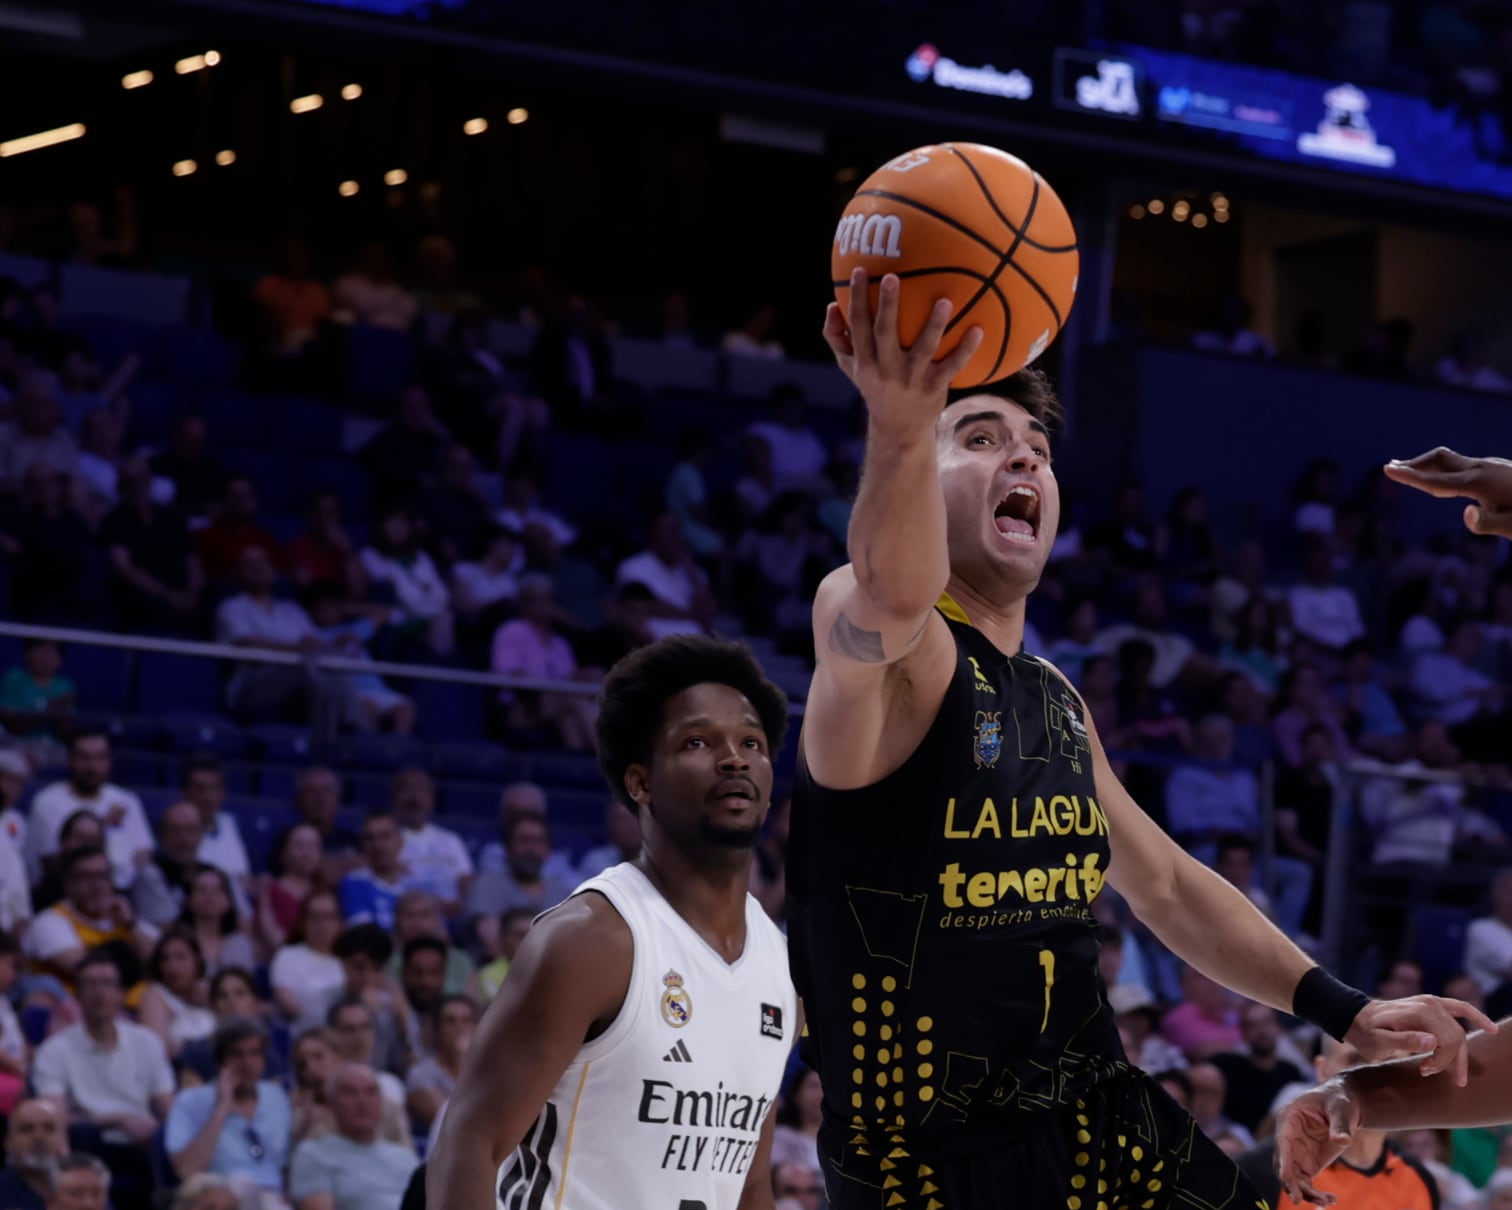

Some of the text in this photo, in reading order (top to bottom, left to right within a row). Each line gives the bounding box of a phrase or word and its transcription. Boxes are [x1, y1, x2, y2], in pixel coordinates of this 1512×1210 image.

[944, 798, 1002, 839] LA
[939, 909, 1032, 931] despierta
[661, 1135, 759, 1175] FLY ETTE
